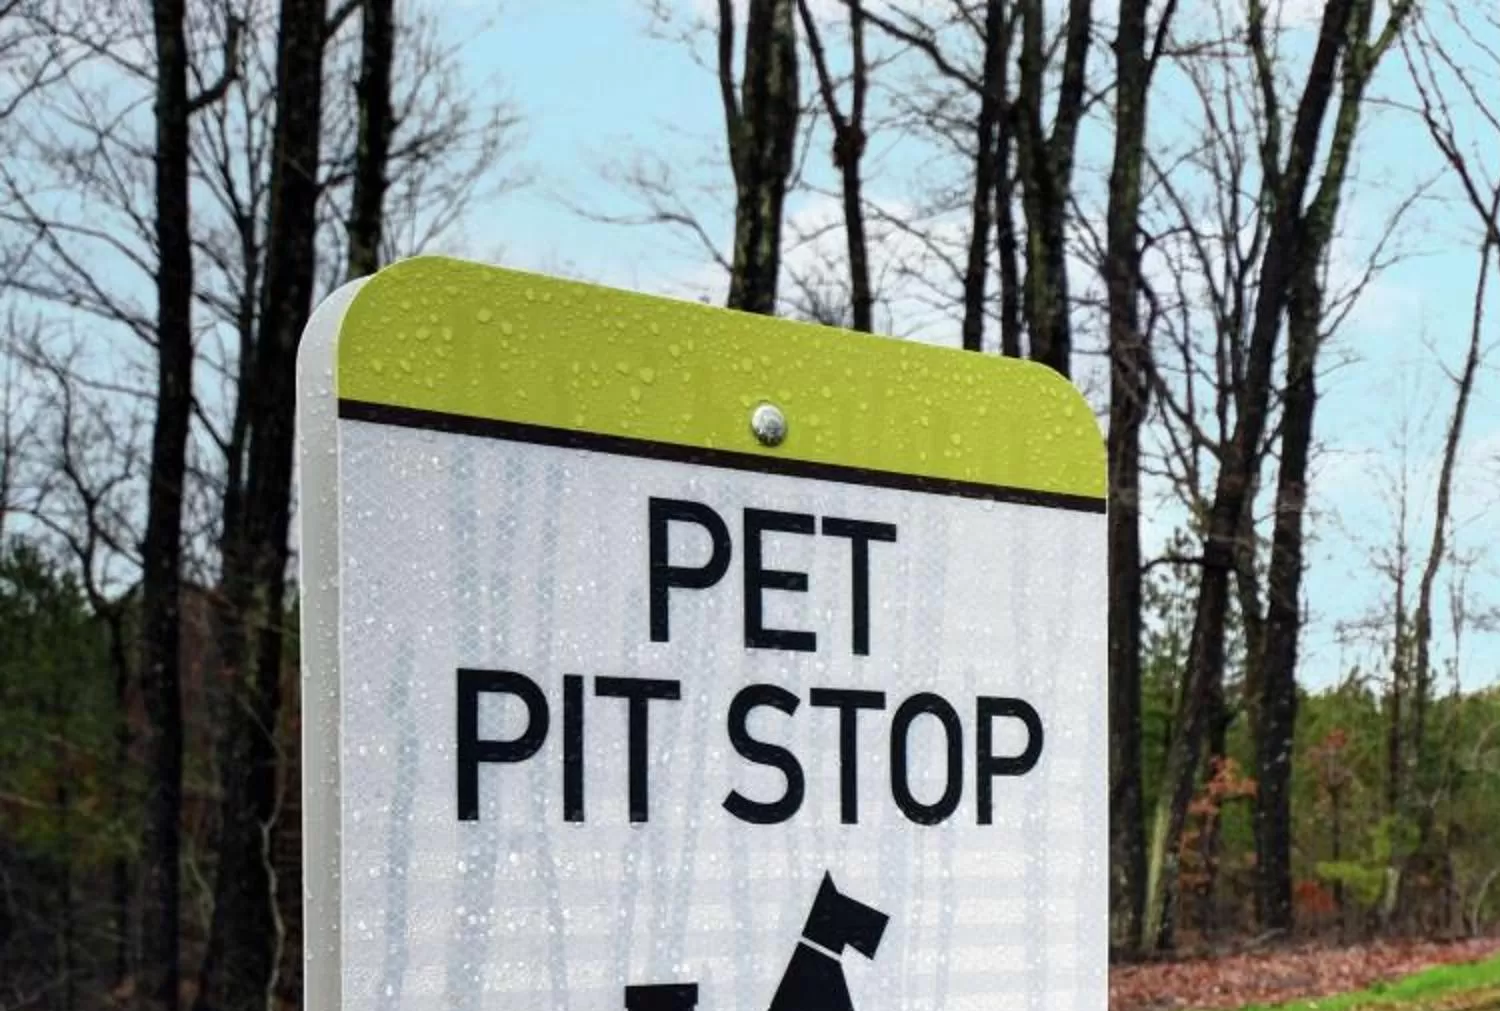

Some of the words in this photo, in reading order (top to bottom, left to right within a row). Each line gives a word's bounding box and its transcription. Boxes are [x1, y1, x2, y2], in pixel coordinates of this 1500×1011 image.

[648, 495, 898, 657] PET
[456, 667, 682, 823] PIT
[721, 682, 1045, 827] STOP
